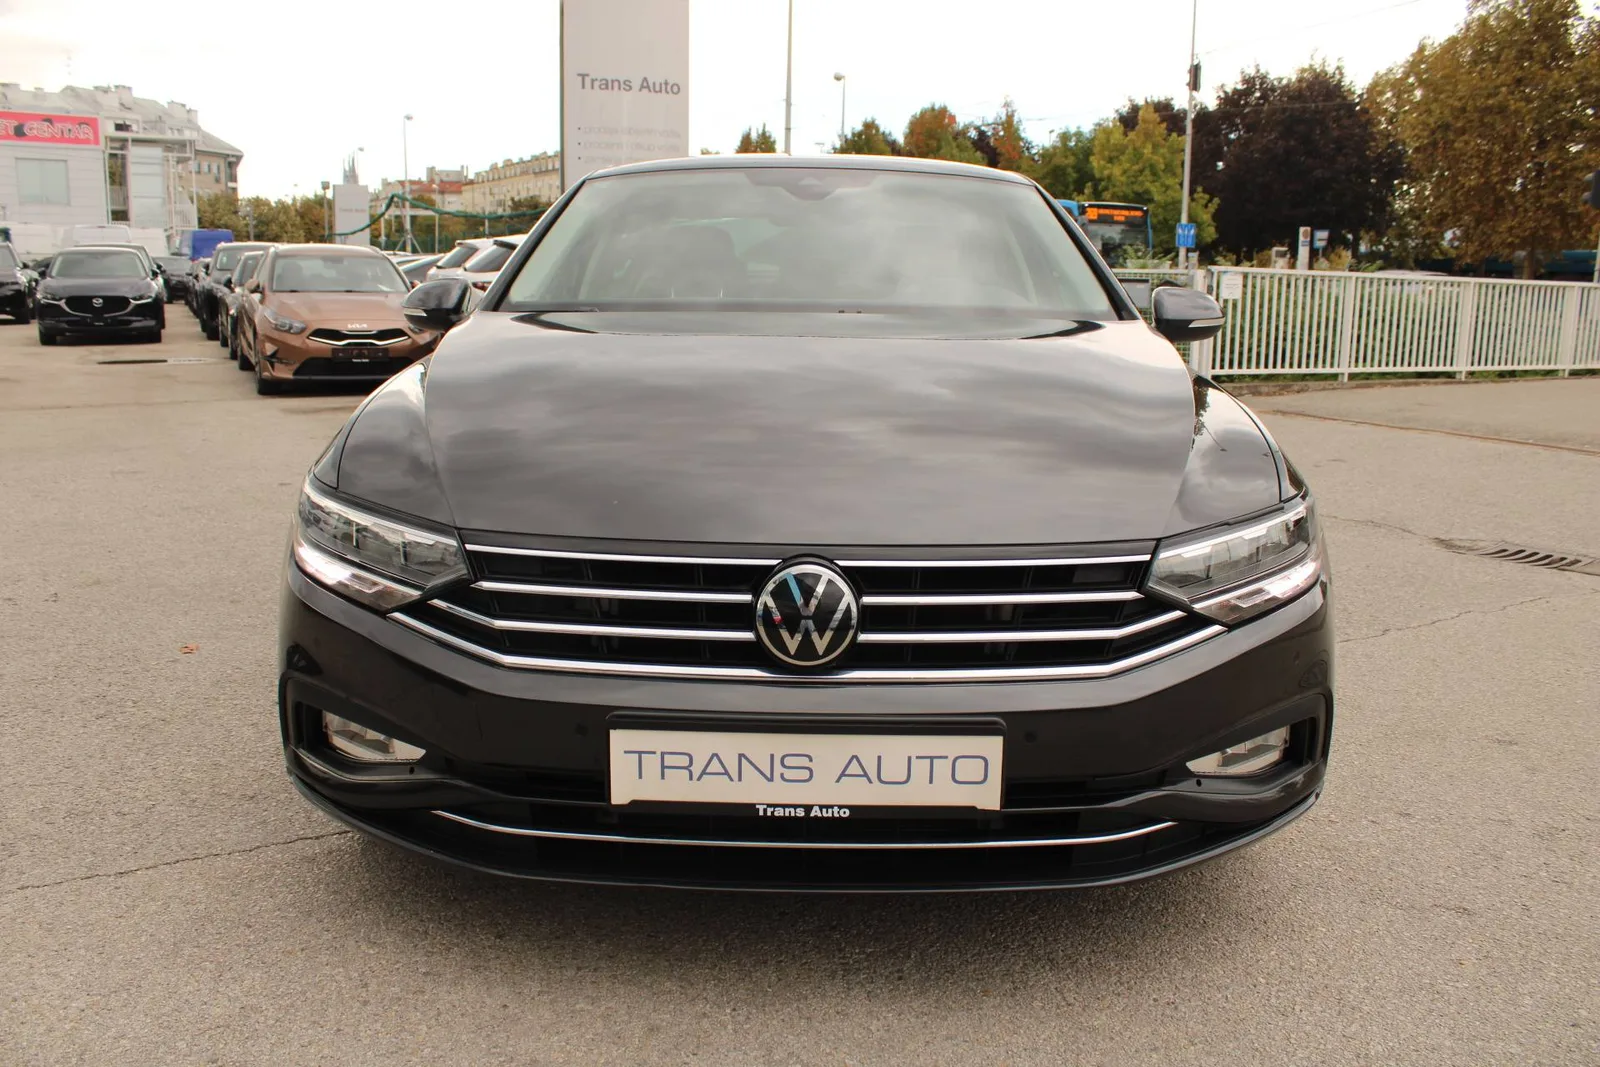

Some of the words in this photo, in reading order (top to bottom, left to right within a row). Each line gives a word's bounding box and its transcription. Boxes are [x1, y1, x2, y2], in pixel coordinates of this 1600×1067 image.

[577, 73, 633, 92] Trans
[638, 76, 681, 95] Auto
[23, 121, 94, 141] CENTAR
[623, 750, 814, 783] TRANS
[835, 754, 990, 785] AUTO
[756, 804, 805, 818] Trans
[810, 805, 850, 819] Auto
